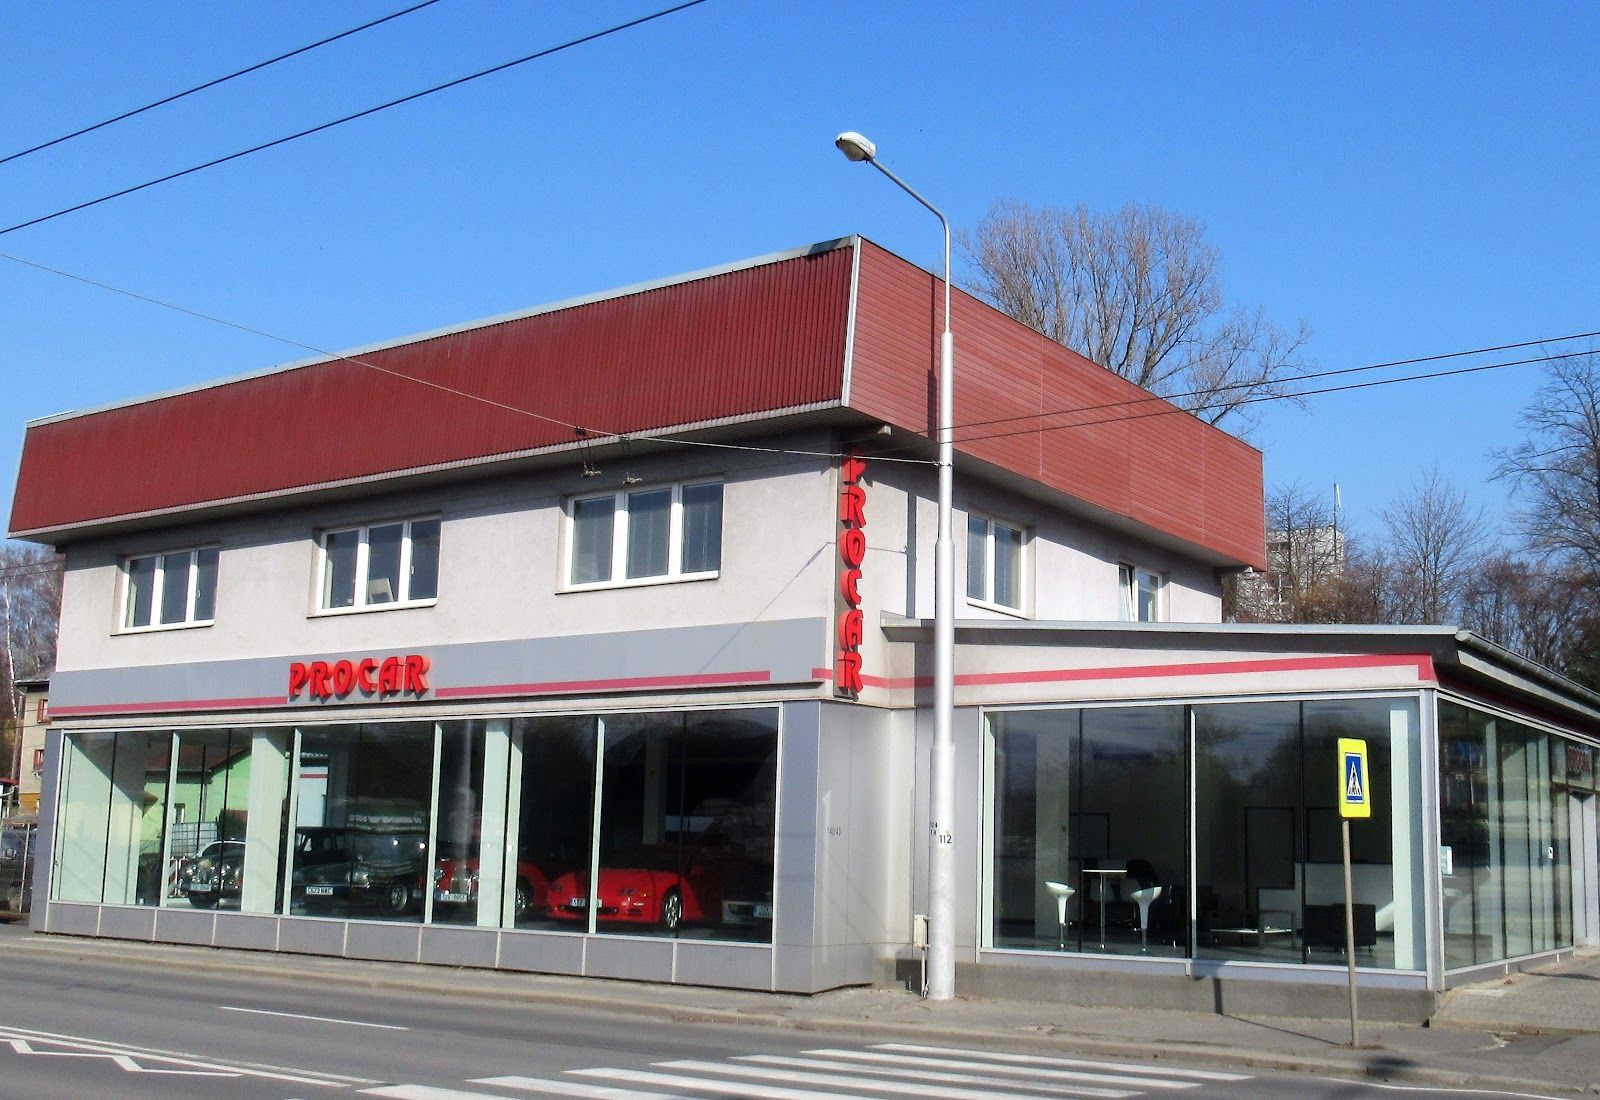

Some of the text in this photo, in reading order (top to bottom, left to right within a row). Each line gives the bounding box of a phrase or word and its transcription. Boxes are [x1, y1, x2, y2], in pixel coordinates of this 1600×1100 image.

[837, 449, 867, 700] PROCAR
[290, 655, 430, 701] PROCAR
[939, 834, 952, 844] 112
